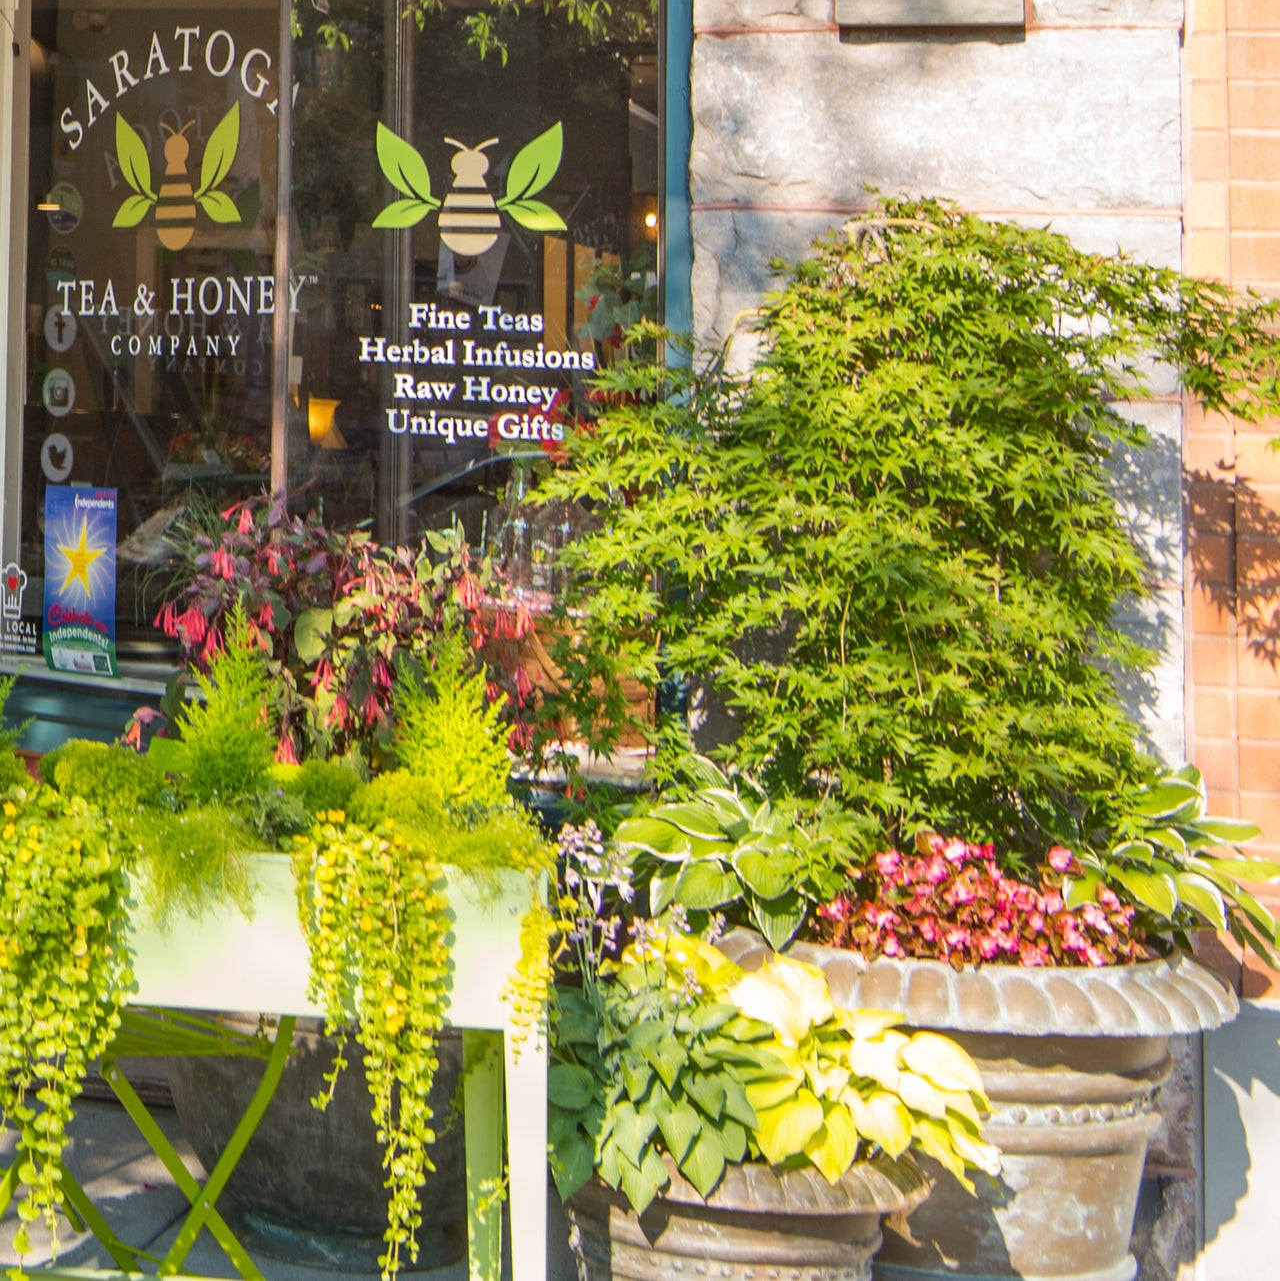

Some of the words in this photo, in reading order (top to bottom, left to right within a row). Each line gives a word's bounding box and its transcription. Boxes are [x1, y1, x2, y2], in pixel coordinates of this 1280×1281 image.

[57, 279, 119, 316] TEA
[133, 283, 155, 315] &
[408, 303, 471, 330] Fine
[478, 304, 545, 332] Teas
[111, 335, 240, 356] COMPANY
[358, 336, 456, 365] Herbal
[462, 339, 596, 370] Infusions
[394, 373, 456, 400] Raw
[462, 376, 559, 412] Honey
[385, 408, 488, 445] Unique
[497, 413, 565, 441] Gifts
[6, 619, 37, 636] LOCAL
